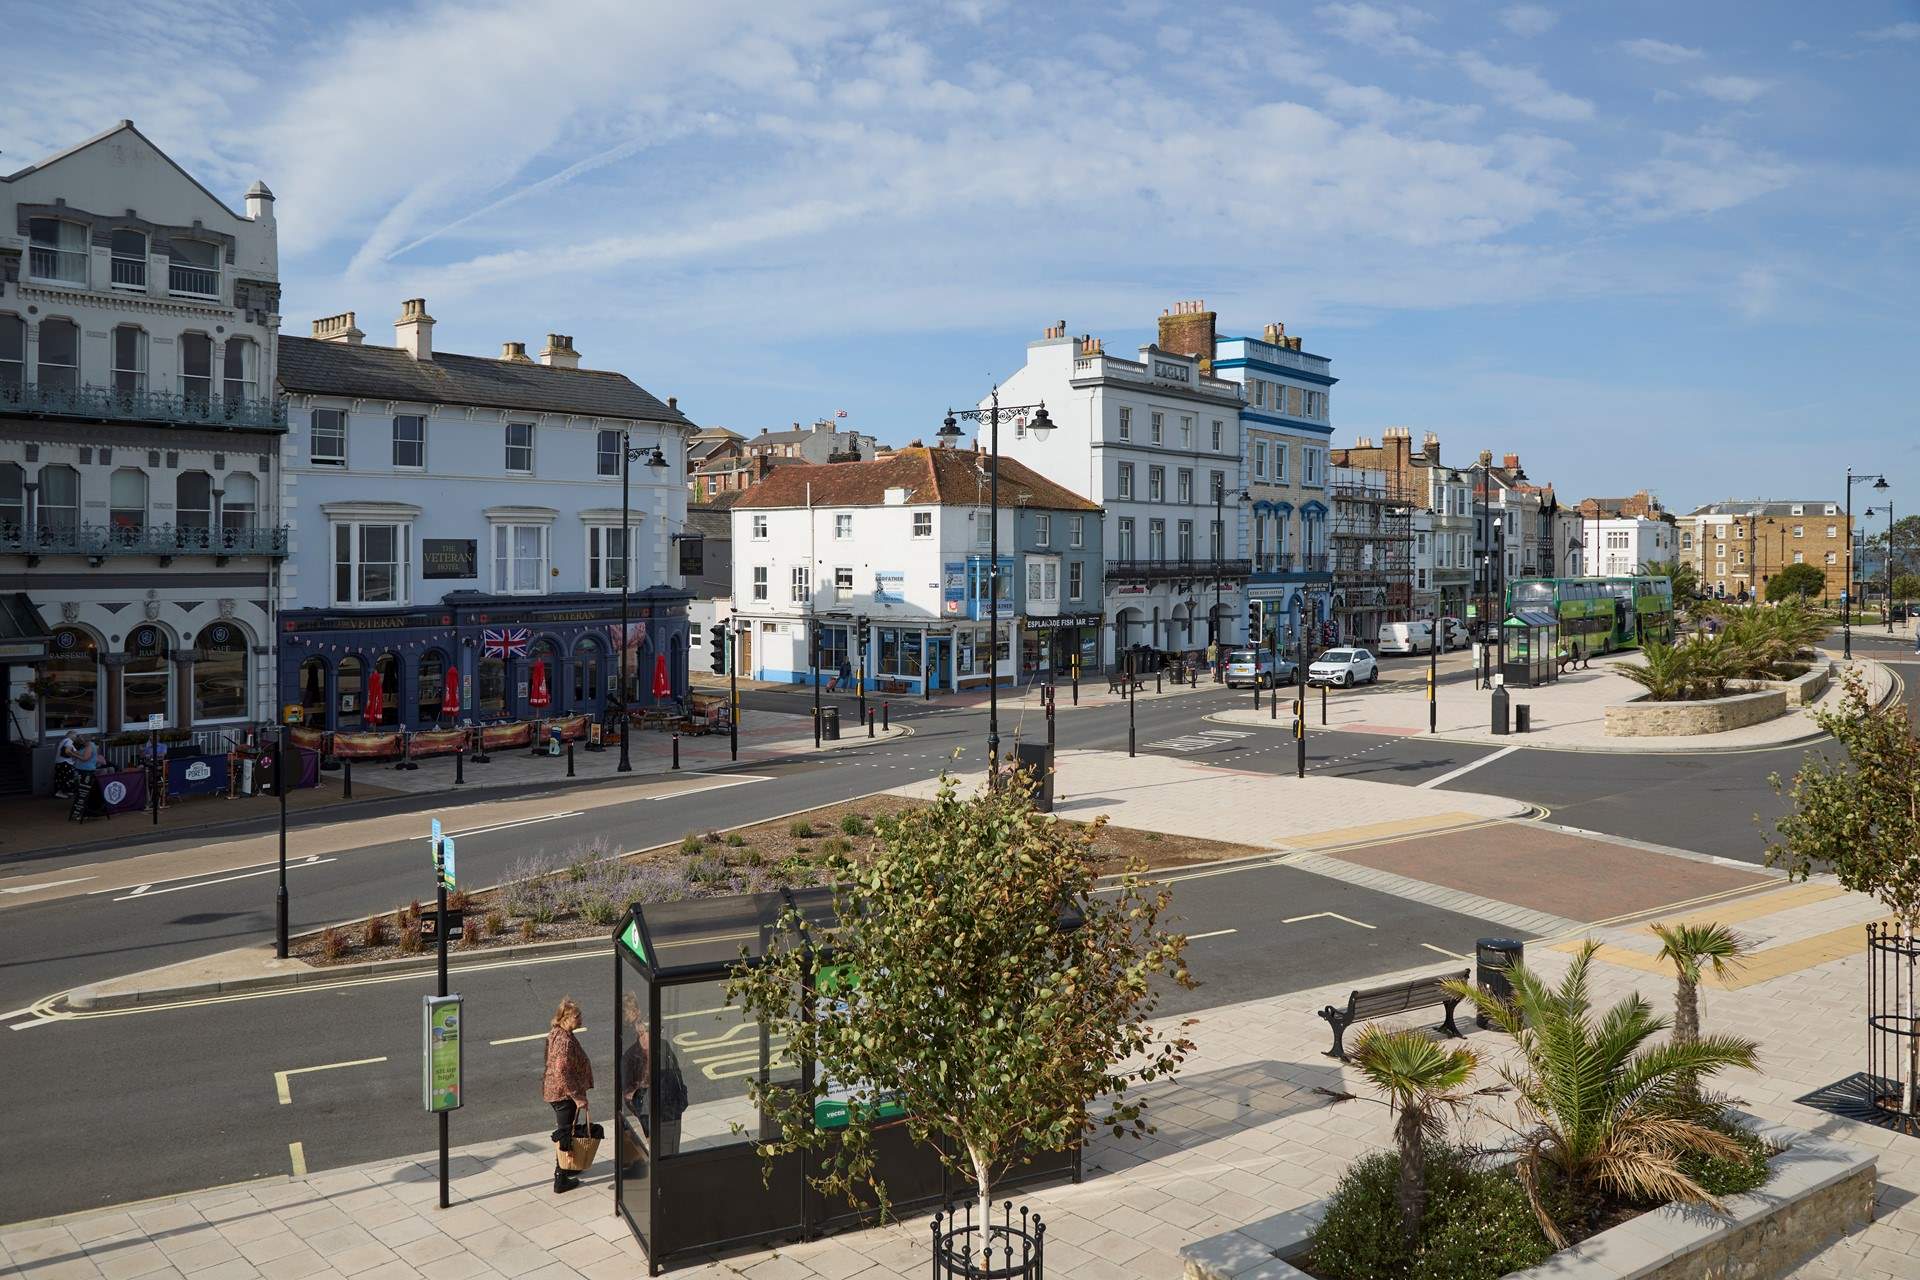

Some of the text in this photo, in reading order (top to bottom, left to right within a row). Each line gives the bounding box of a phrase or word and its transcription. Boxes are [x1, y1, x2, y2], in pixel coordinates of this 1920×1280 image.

[424, 552, 472, 562] VETERAN
[552, 612, 594, 621] VETERAN
[350, 617, 405, 629] VETERAN
